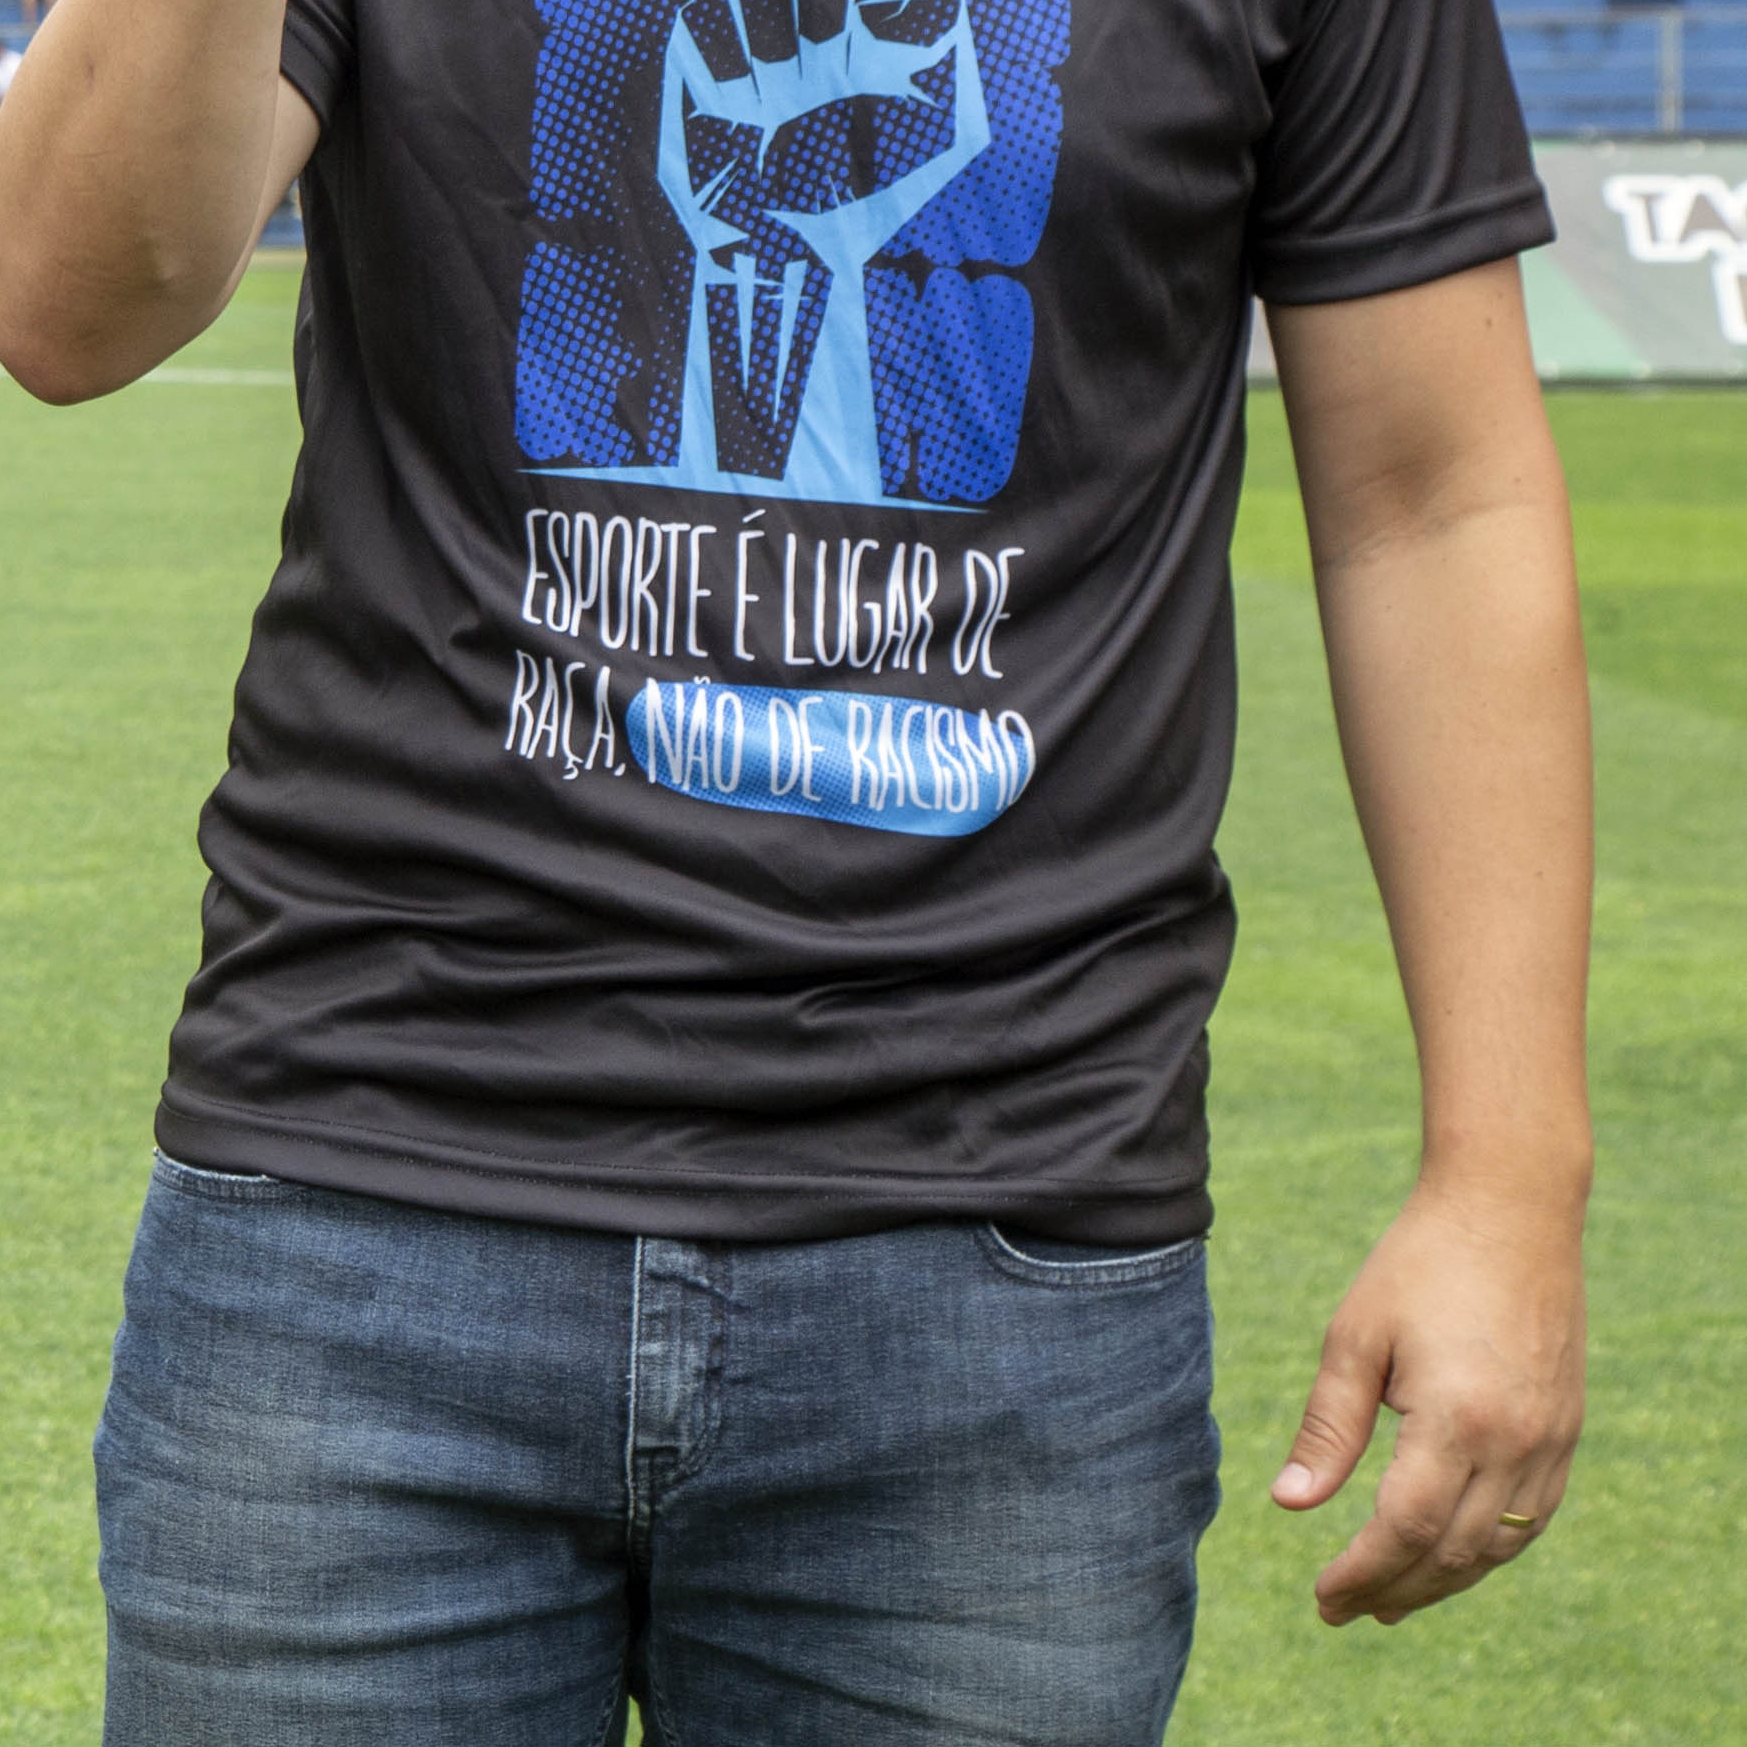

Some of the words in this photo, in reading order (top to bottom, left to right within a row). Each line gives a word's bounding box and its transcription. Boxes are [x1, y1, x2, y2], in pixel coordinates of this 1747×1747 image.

[521, 508, 718, 658] ESPORTE
[734, 508, 766, 662] É
[783, 532, 938, 674] LUGAR
[951, 547, 1026, 679] DE
[504, 649, 626, 780] RAÇA,
[645, 674, 744, 794] NÃO
[768, 695, 825, 802] DE
[847, 698, 1037, 813] RACISMO
